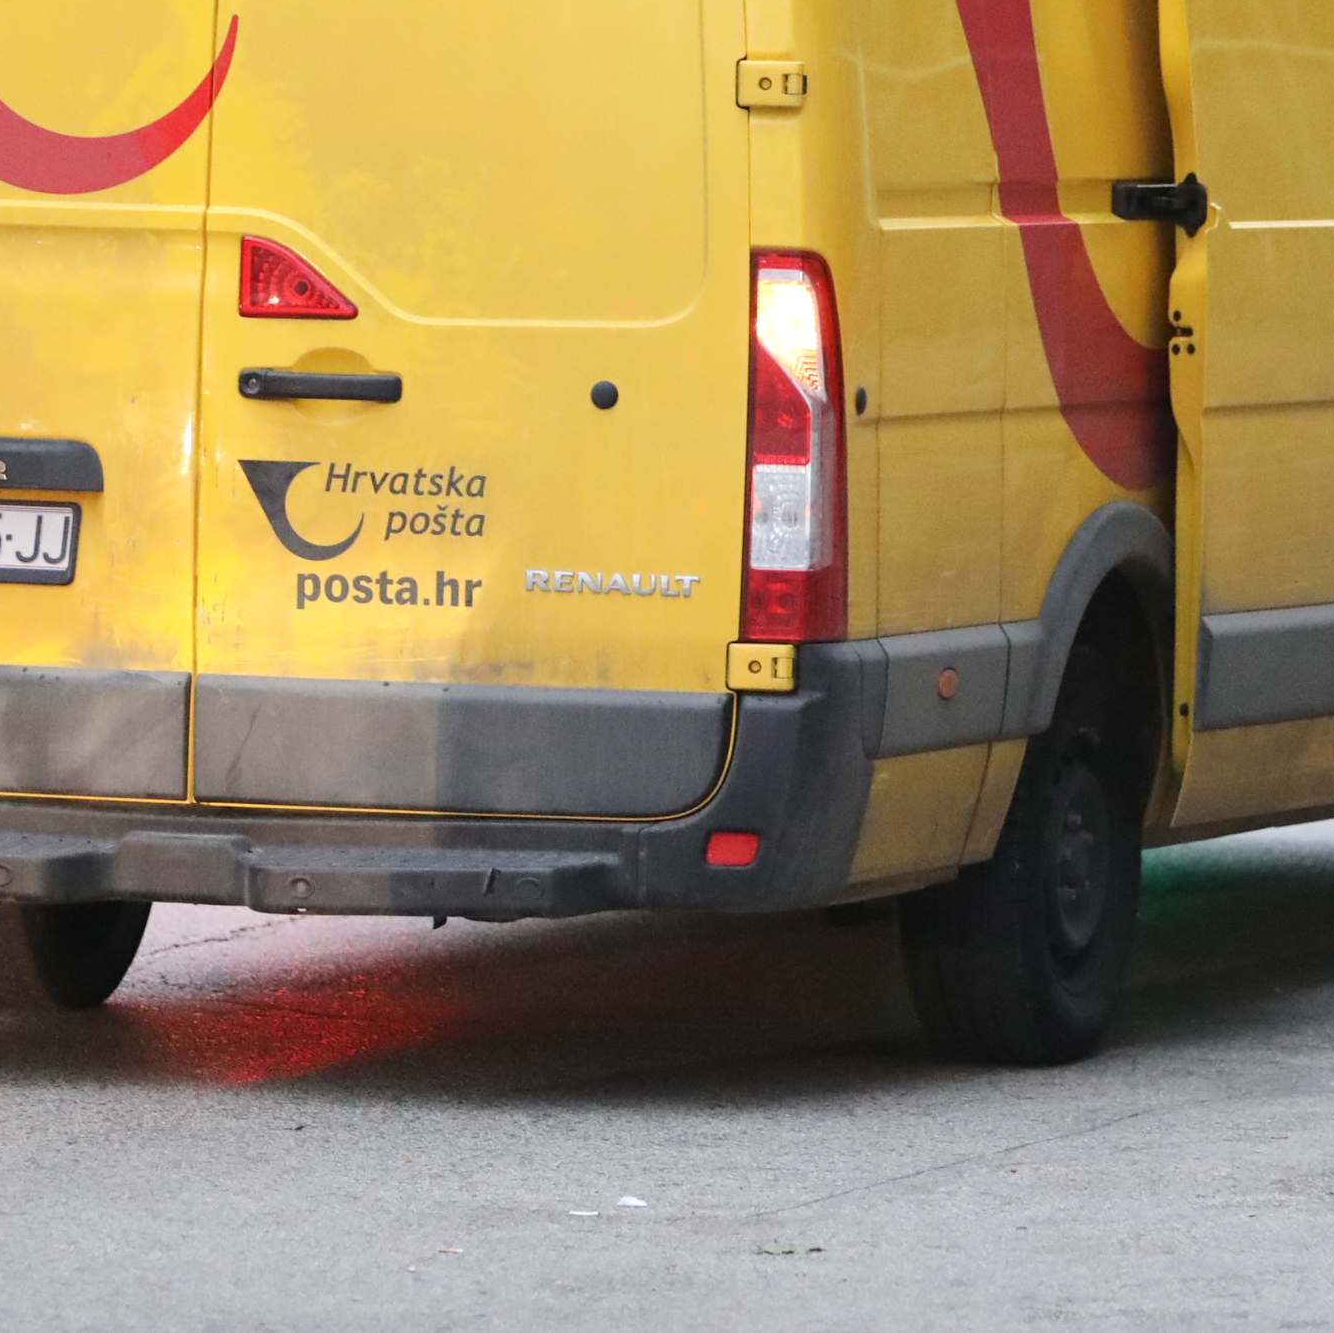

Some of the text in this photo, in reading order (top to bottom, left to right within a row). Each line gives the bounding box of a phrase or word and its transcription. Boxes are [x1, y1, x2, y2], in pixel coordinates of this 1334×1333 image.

[324, 462, 487, 498] Hrvatska
[384, 505, 486, 541] pošta
[295, 570, 483, 609] posta.hr
[523, 569, 701, 597] RENAULT
